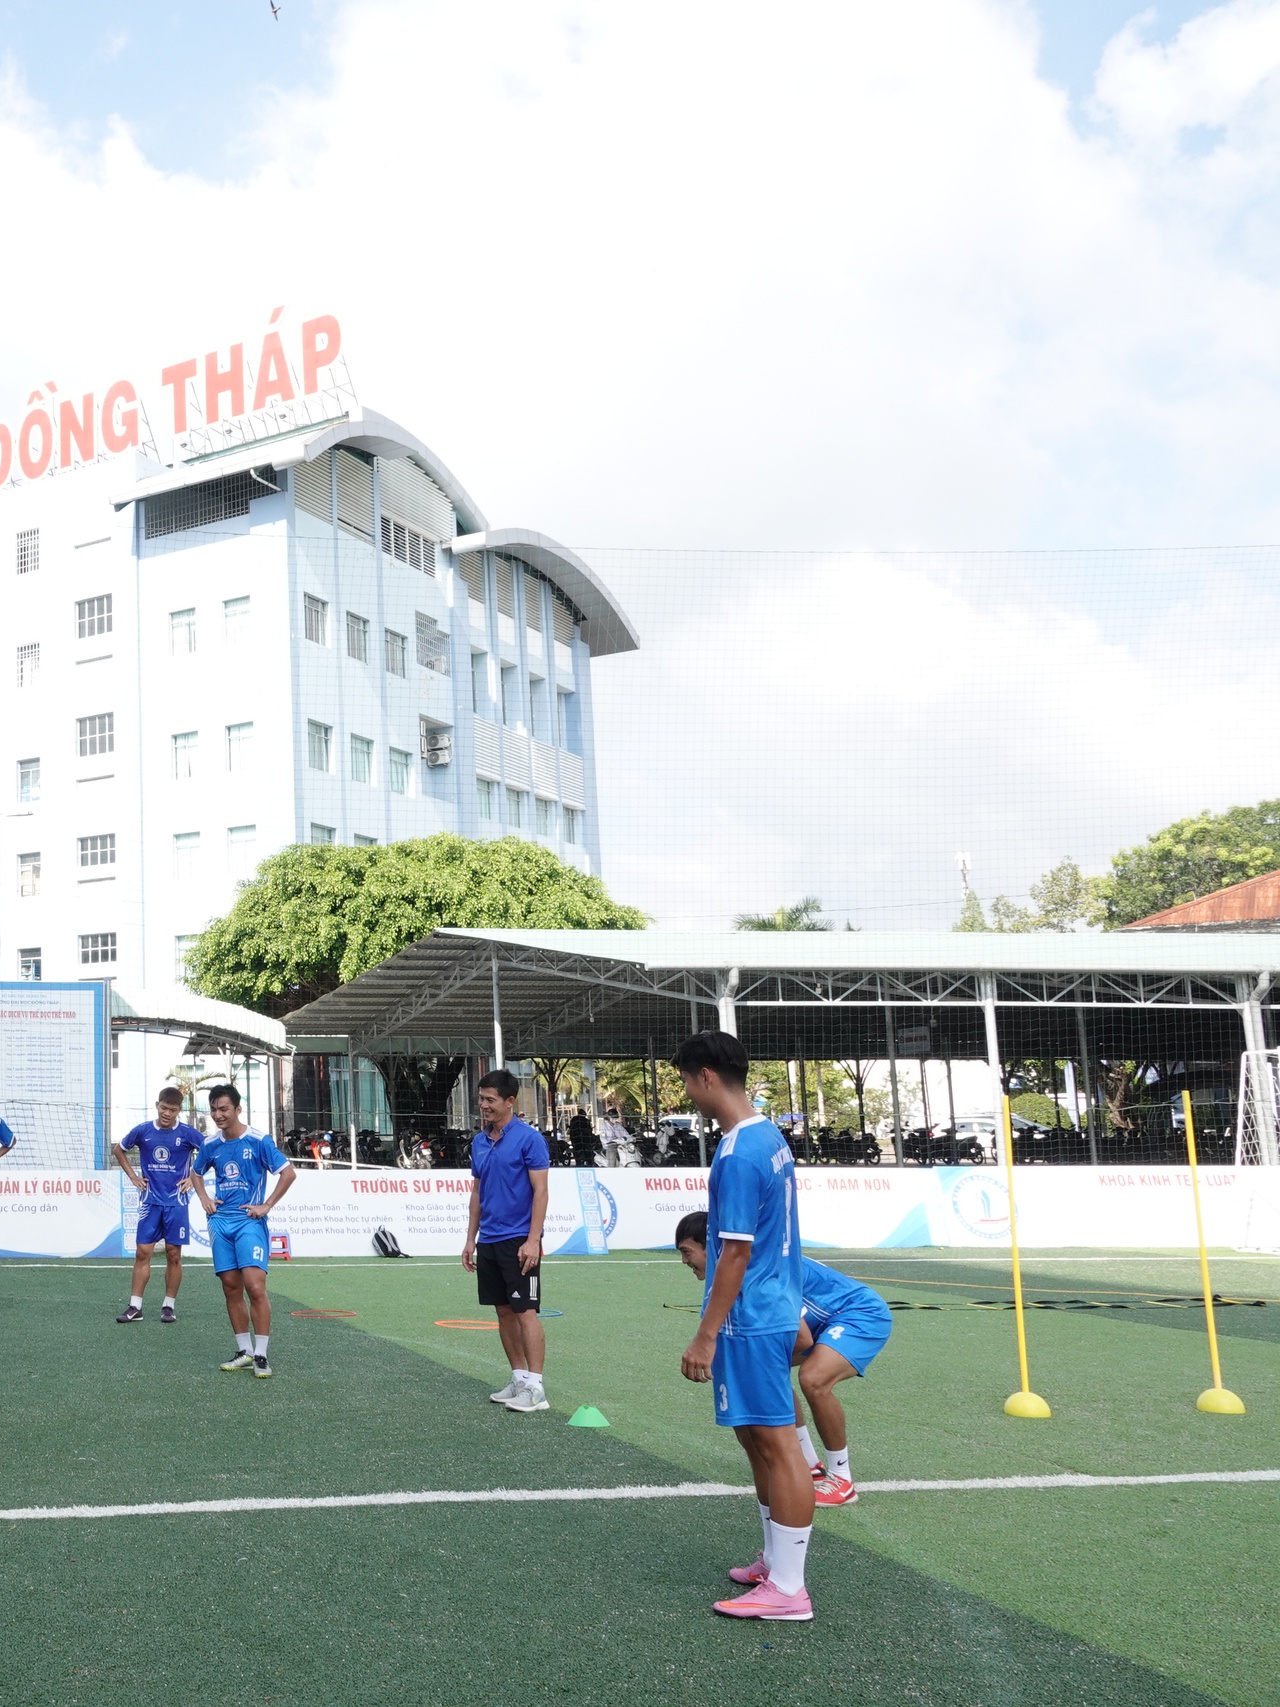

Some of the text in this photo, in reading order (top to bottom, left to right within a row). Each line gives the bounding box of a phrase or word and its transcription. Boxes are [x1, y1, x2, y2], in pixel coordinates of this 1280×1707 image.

[162, 304, 342, 436] THÁP
[176, 1138, 181, 1146] 6
[243, 1148, 252, 1159] 21
[645, 1175, 708, 1191] KHOA GIÁ
[1099, 1175, 1135, 1186] KHOA
[1139, 1175, 1171, 1186] KINH
[24, 1177, 38, 1194] LÝ
[43, 1177, 71, 1194] GIÁO
[76, 1180, 102, 1196] DỤC
[351, 1177, 475, 1196] TRƯỜNG SƯ PHẠM
[11, 1204, 37, 1214] Công
[40, 1204, 58, 1212] dân
[299, 1205, 321, 1214] phạm
[447, 1204, 460, 1212] dục
[654, 1203, 679, 1212] Giáo
[681, 1203, 695, 1214] dục
[288, 1215, 299, 1223] Sư
[300, 1217, 322, 1226] phạm
[324, 1215, 343, 1223] Khoa
[346, 1215, 359, 1224] học
[361, 1215, 370, 1224] tự
[448, 1215, 461, 1224] dục
[180, 1226, 186, 1239] 6
[302, 1228, 324, 1237] phạm
[346, 1227, 360, 1236] học
[451, 1227, 462, 1235] dục
[559, 1226, 572, 1234] dục
[253, 1246, 264, 1262] 21
[827, 1325, 845, 1340] 4
[720, 1384, 728, 1412] 3
